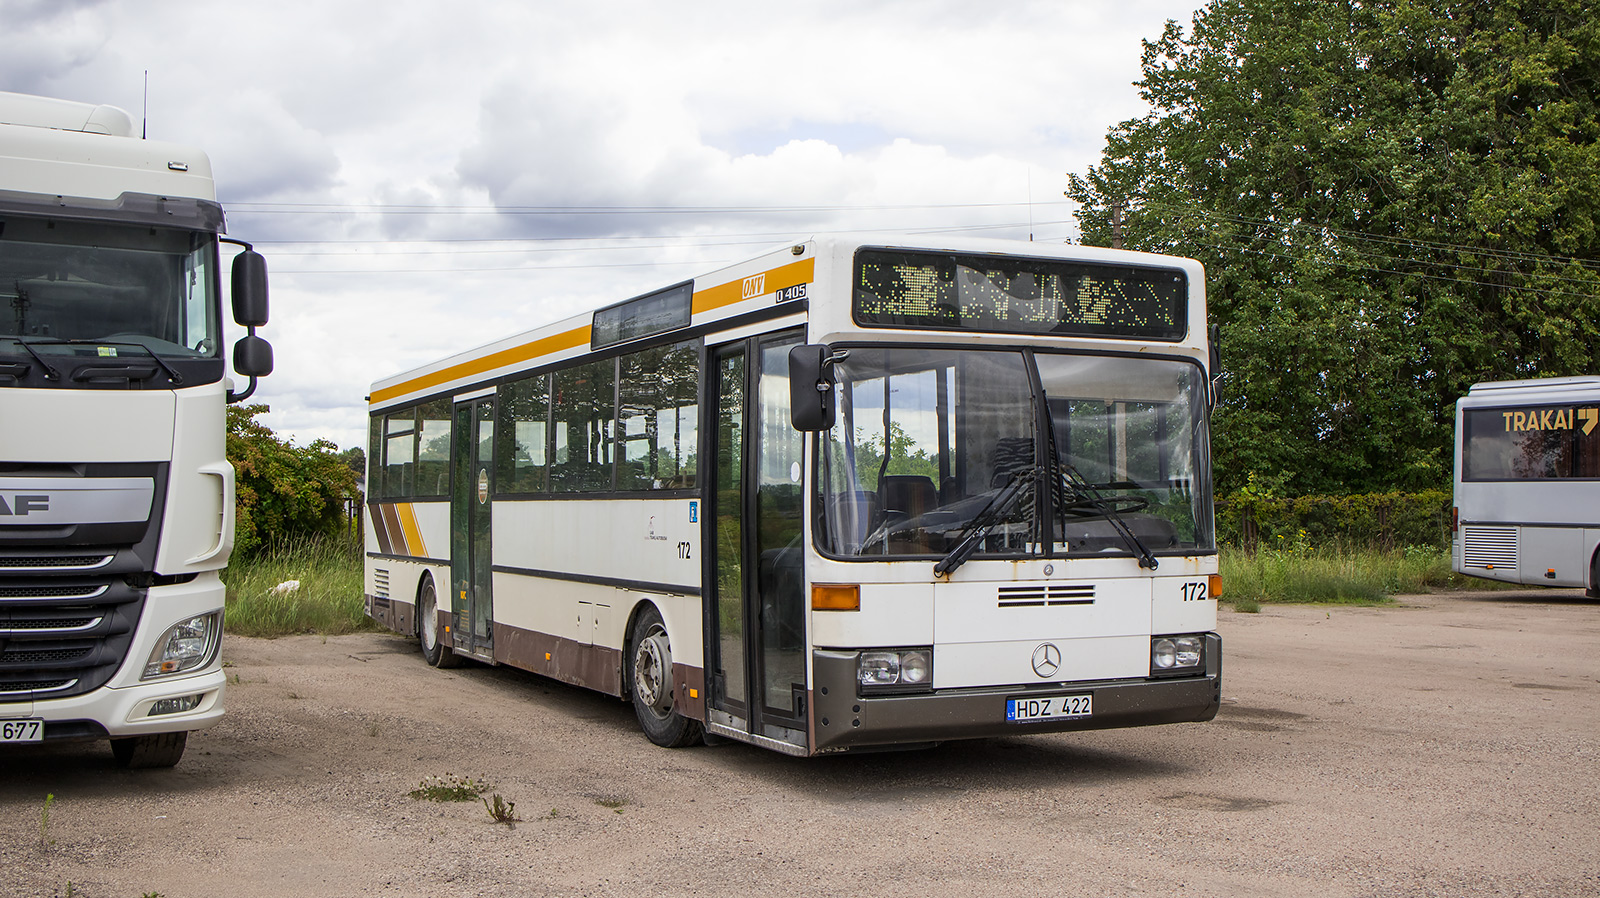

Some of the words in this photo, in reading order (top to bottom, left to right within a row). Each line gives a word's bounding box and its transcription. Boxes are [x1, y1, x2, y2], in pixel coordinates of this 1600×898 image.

[743, 275, 765, 298] ONV
[785, 284, 806, 299] 405
[1502, 408, 1574, 432] TRAKAI
[677, 541, 691, 559] 172
[1180, 582, 1207, 602] 172
[1017, 699, 1052, 718] HDZ
[1062, 697, 1090, 715] 422
[3, 721, 40, 740] 677
